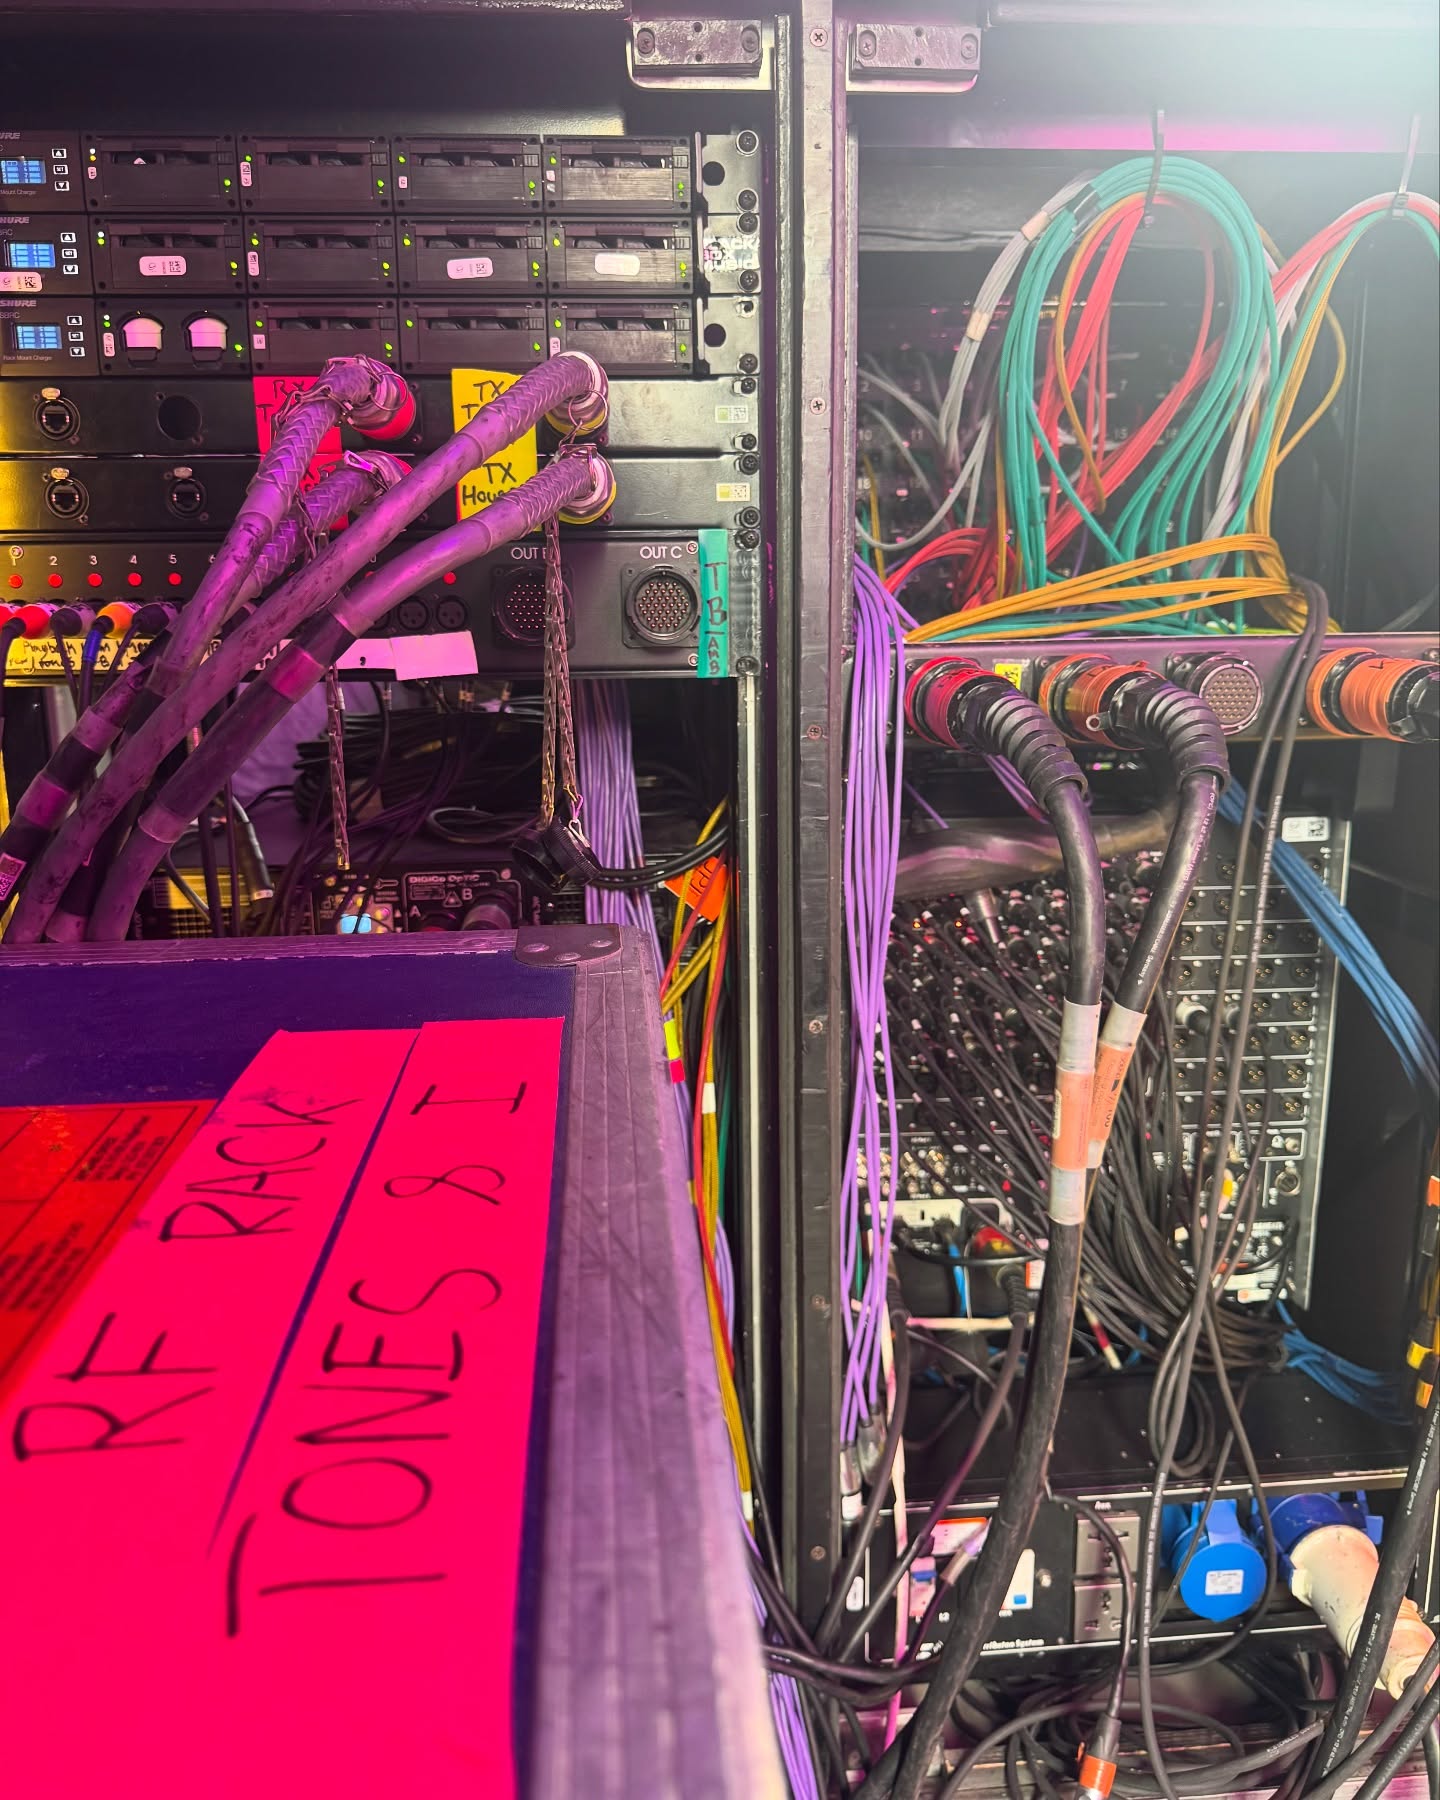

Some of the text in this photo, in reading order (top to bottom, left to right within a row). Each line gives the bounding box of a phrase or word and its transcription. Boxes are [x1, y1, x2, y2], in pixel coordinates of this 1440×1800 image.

[0, 299, 37, 308] SHURE
[473, 380, 505, 402] TX
[482, 462, 517, 485] TX
[462, 484, 517, 506] Hou
[511, 547, 538, 560] OUT
[639, 546, 683, 560] OUT C
[49, 555, 59, 566] 2
[89, 555, 99, 566] 3
[129, 554, 138, 565] 4
[169, 554, 178, 565] 5
[462, 888, 473, 900] B
[409, 905, 421, 917] A
[12, 1312, 218, 1463] RF
[157, 1098, 366, 1243] RACK
[225, 1268, 503, 1639] TONES
[410, 1081, 527, 1117] I
